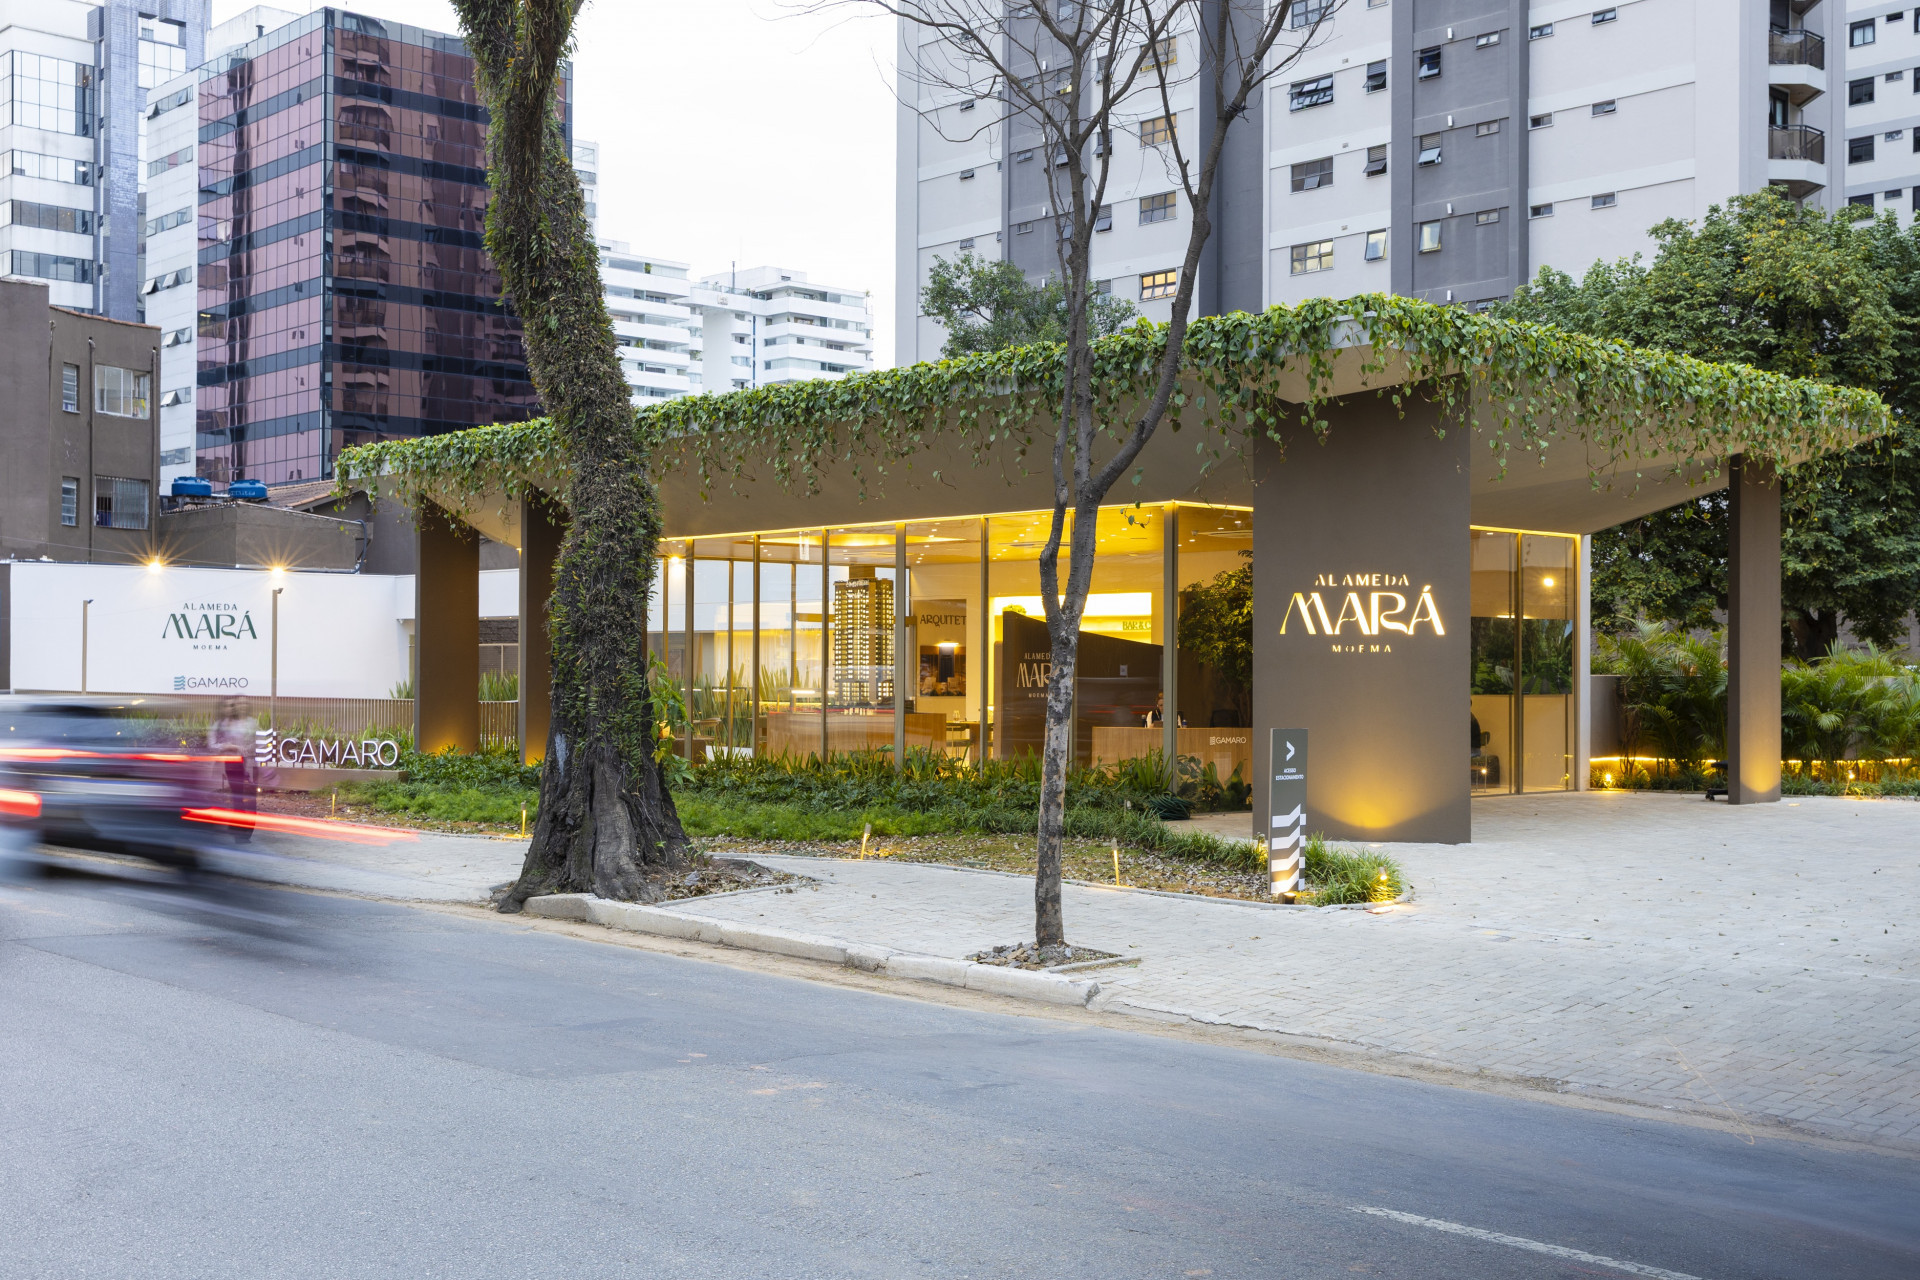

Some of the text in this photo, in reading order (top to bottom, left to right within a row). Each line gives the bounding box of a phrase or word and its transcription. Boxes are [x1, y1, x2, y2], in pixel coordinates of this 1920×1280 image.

[1315, 574, 1409, 586] ALAMEDA
[183, 603, 238, 611] ALAMEDA
[1279, 585, 1446, 636] MARÁ
[162, 610, 257, 639] MARÁ
[1332, 644, 1392, 653] MOEMA
[1023, 652, 1051, 660] ALAMED
[1016, 662, 1052, 688] MAR
[187, 677, 249, 688] GAMARO
[1215, 736, 1247, 744] GAMARO
[280, 738, 399, 767] GAMARO
